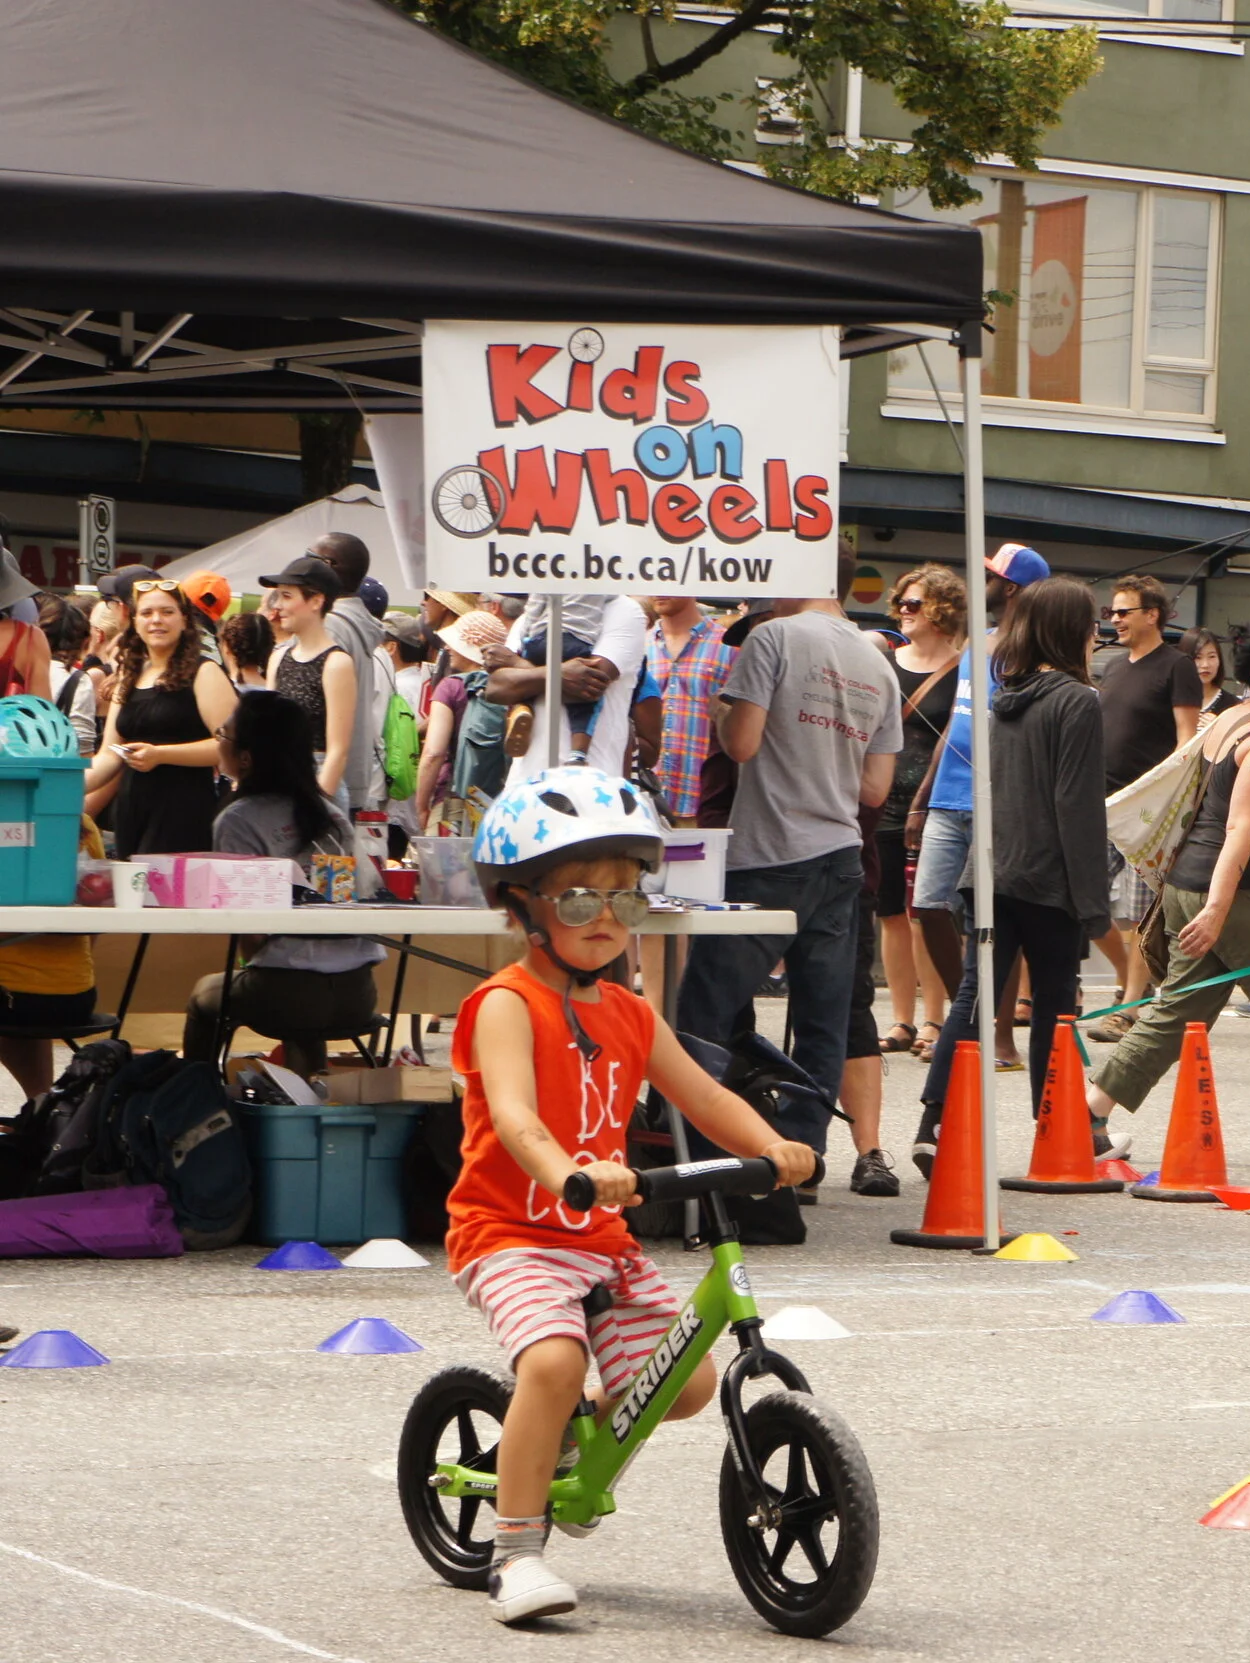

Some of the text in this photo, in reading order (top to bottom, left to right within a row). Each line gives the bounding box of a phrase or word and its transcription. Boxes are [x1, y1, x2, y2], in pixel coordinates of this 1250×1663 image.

[486, 327, 710, 427] Kids
[634, 419, 743, 481] on
[477, 445, 834, 544] Wheels
[488, 541, 773, 585] bccc.bc.ca/kow
[3, 827, 23, 840] XS
[611, 1303, 703, 1445] STRIDER
